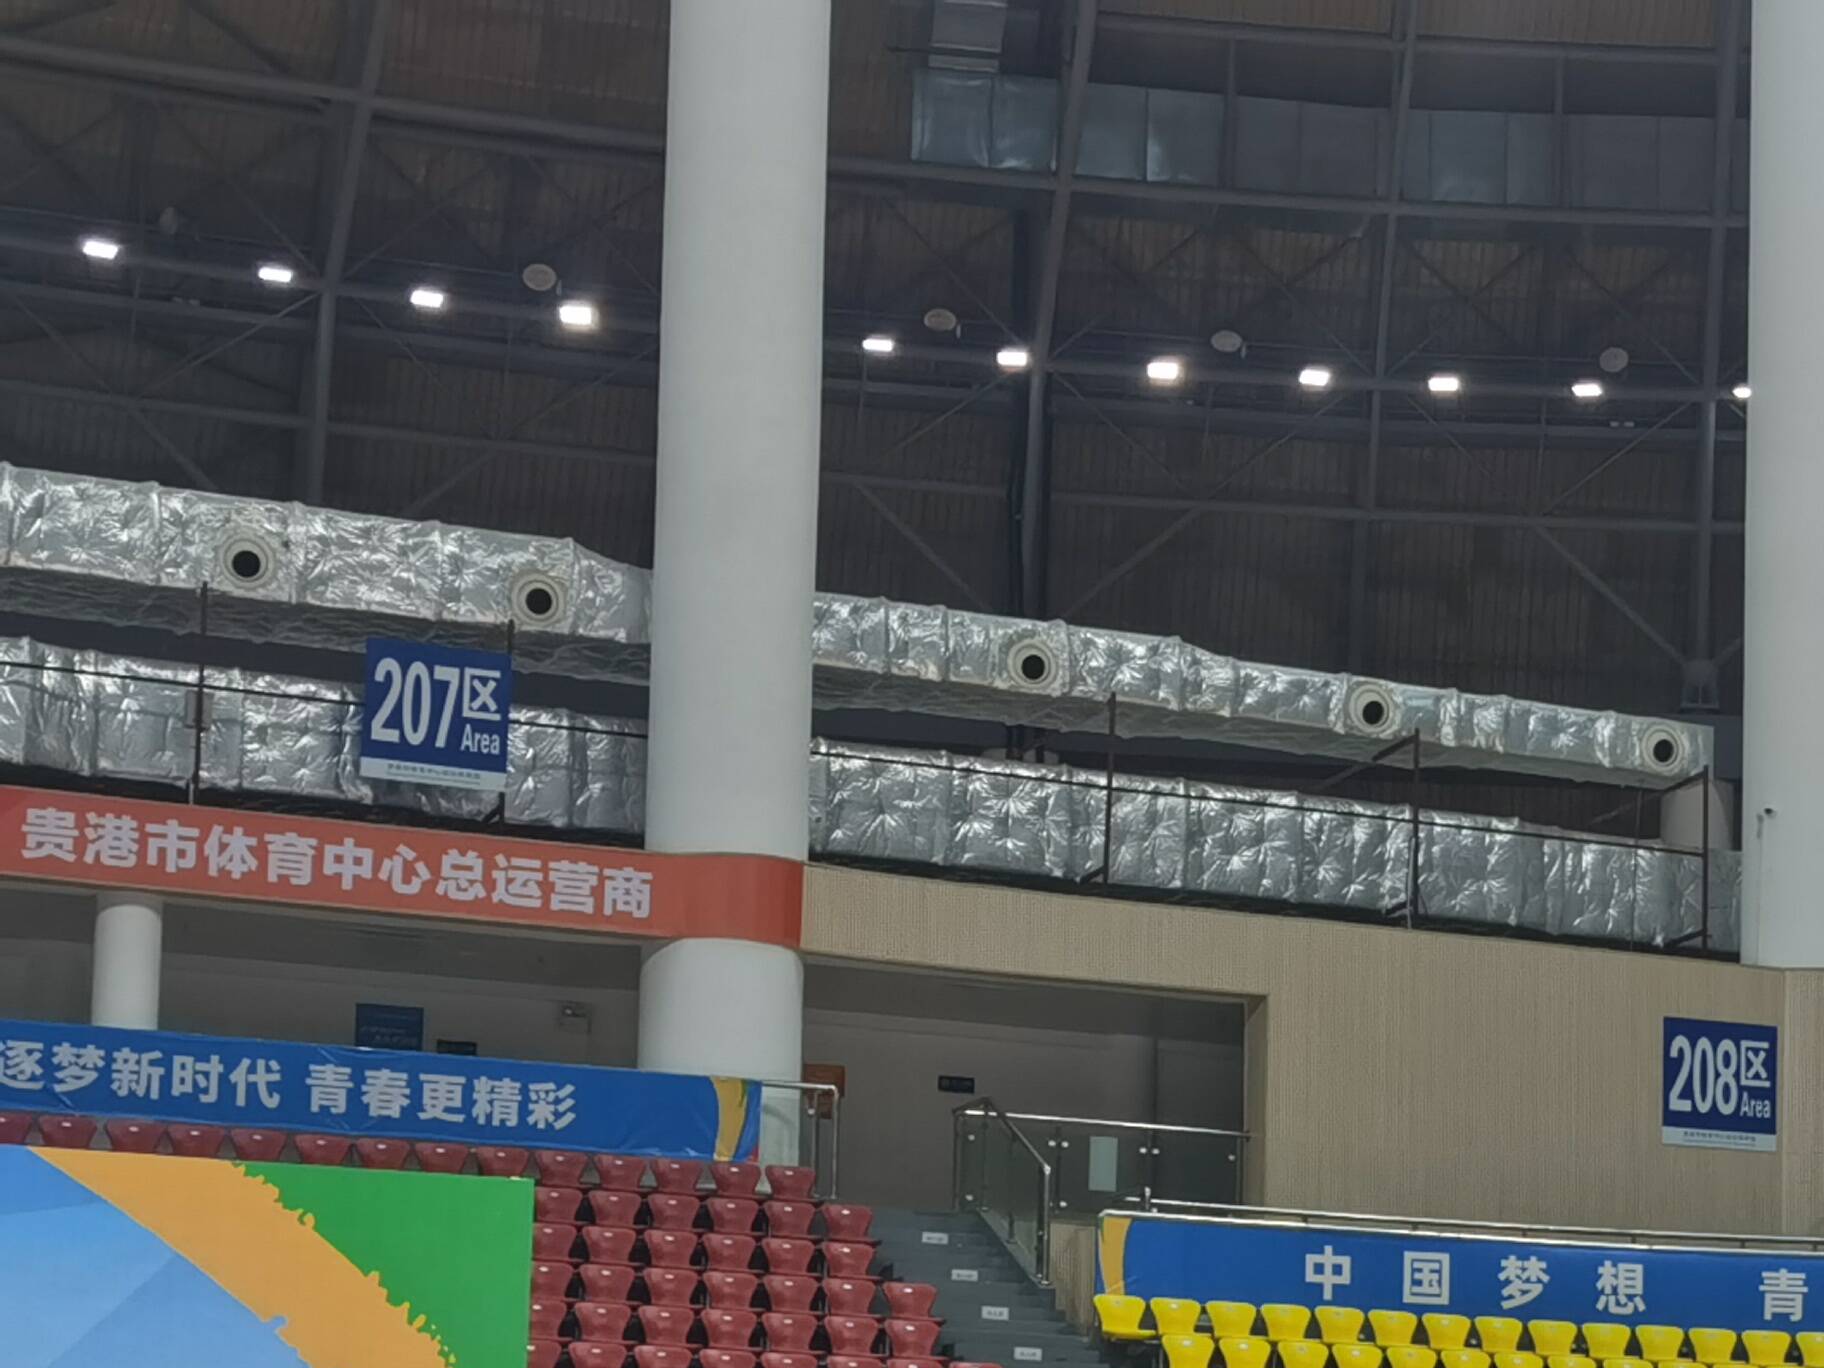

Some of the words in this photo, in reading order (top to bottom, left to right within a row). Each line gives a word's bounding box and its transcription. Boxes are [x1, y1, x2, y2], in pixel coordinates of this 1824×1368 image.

[461, 723, 500, 755] Area
[20, 806, 654, 919] 贵港市体育中心总运营商
[0, 1039, 282, 1109] 逐梦新时代
[305, 1063, 577, 1131] 青春更精彩
[1740, 1091, 1771, 1118] Area
[1305, 1245, 1646, 1315] 中国梦想
